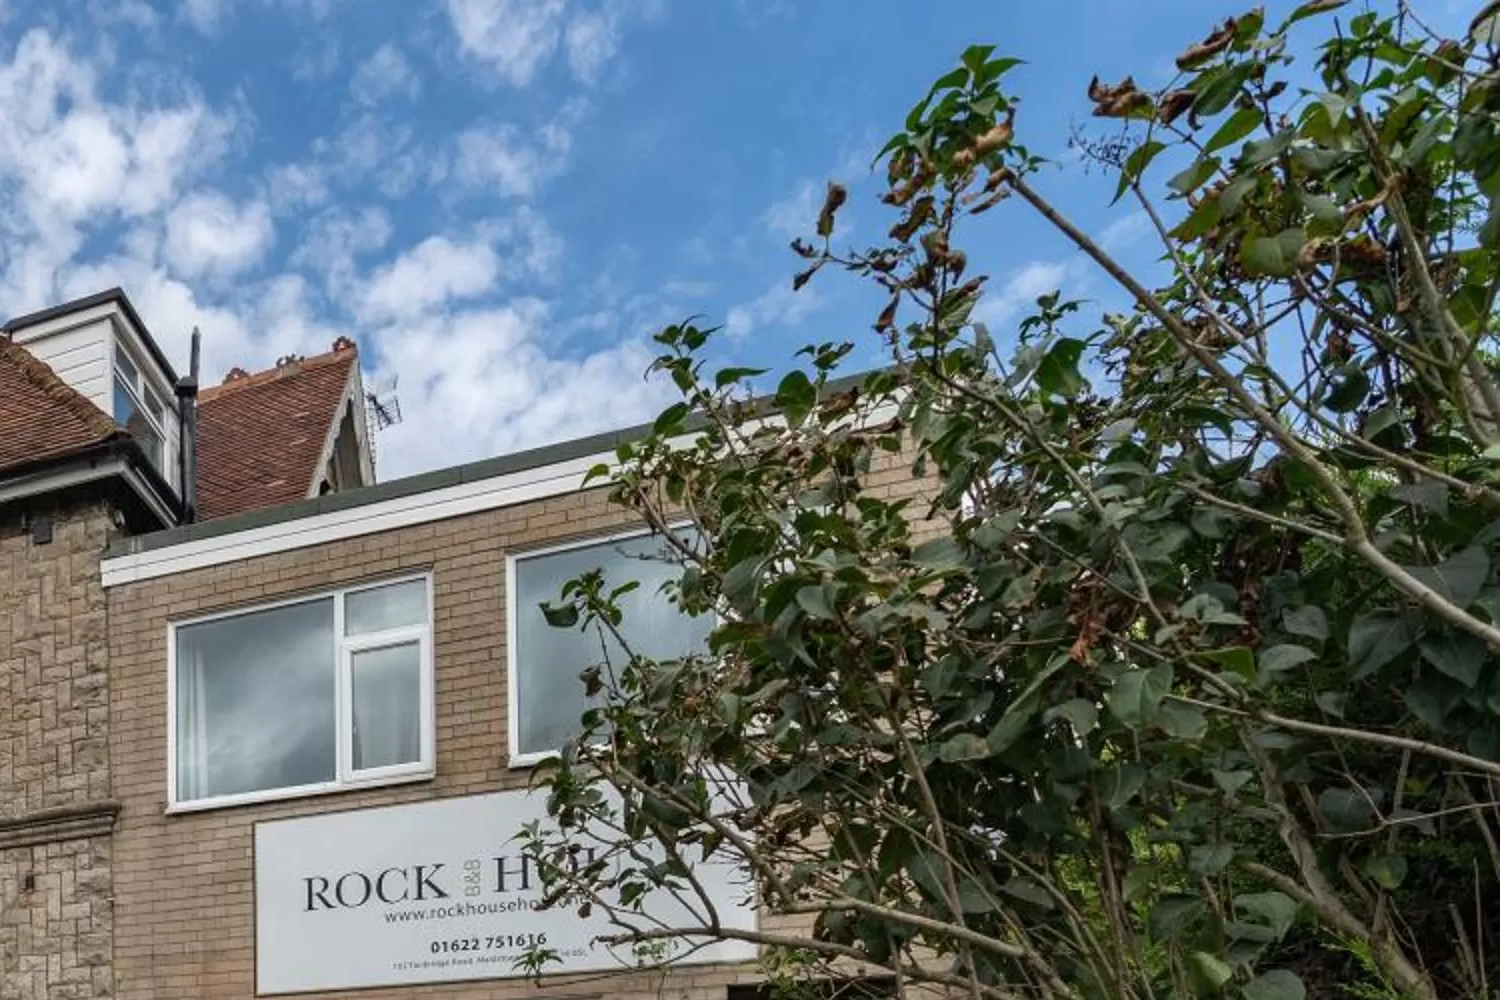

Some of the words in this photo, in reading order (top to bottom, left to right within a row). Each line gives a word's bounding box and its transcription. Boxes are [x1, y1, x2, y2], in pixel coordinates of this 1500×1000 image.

[302, 863, 449, 912] ROCK
[464, 859, 481, 897] B&B
[430, 938, 480, 954] 01622
[485, 931, 548, 949] 751616
